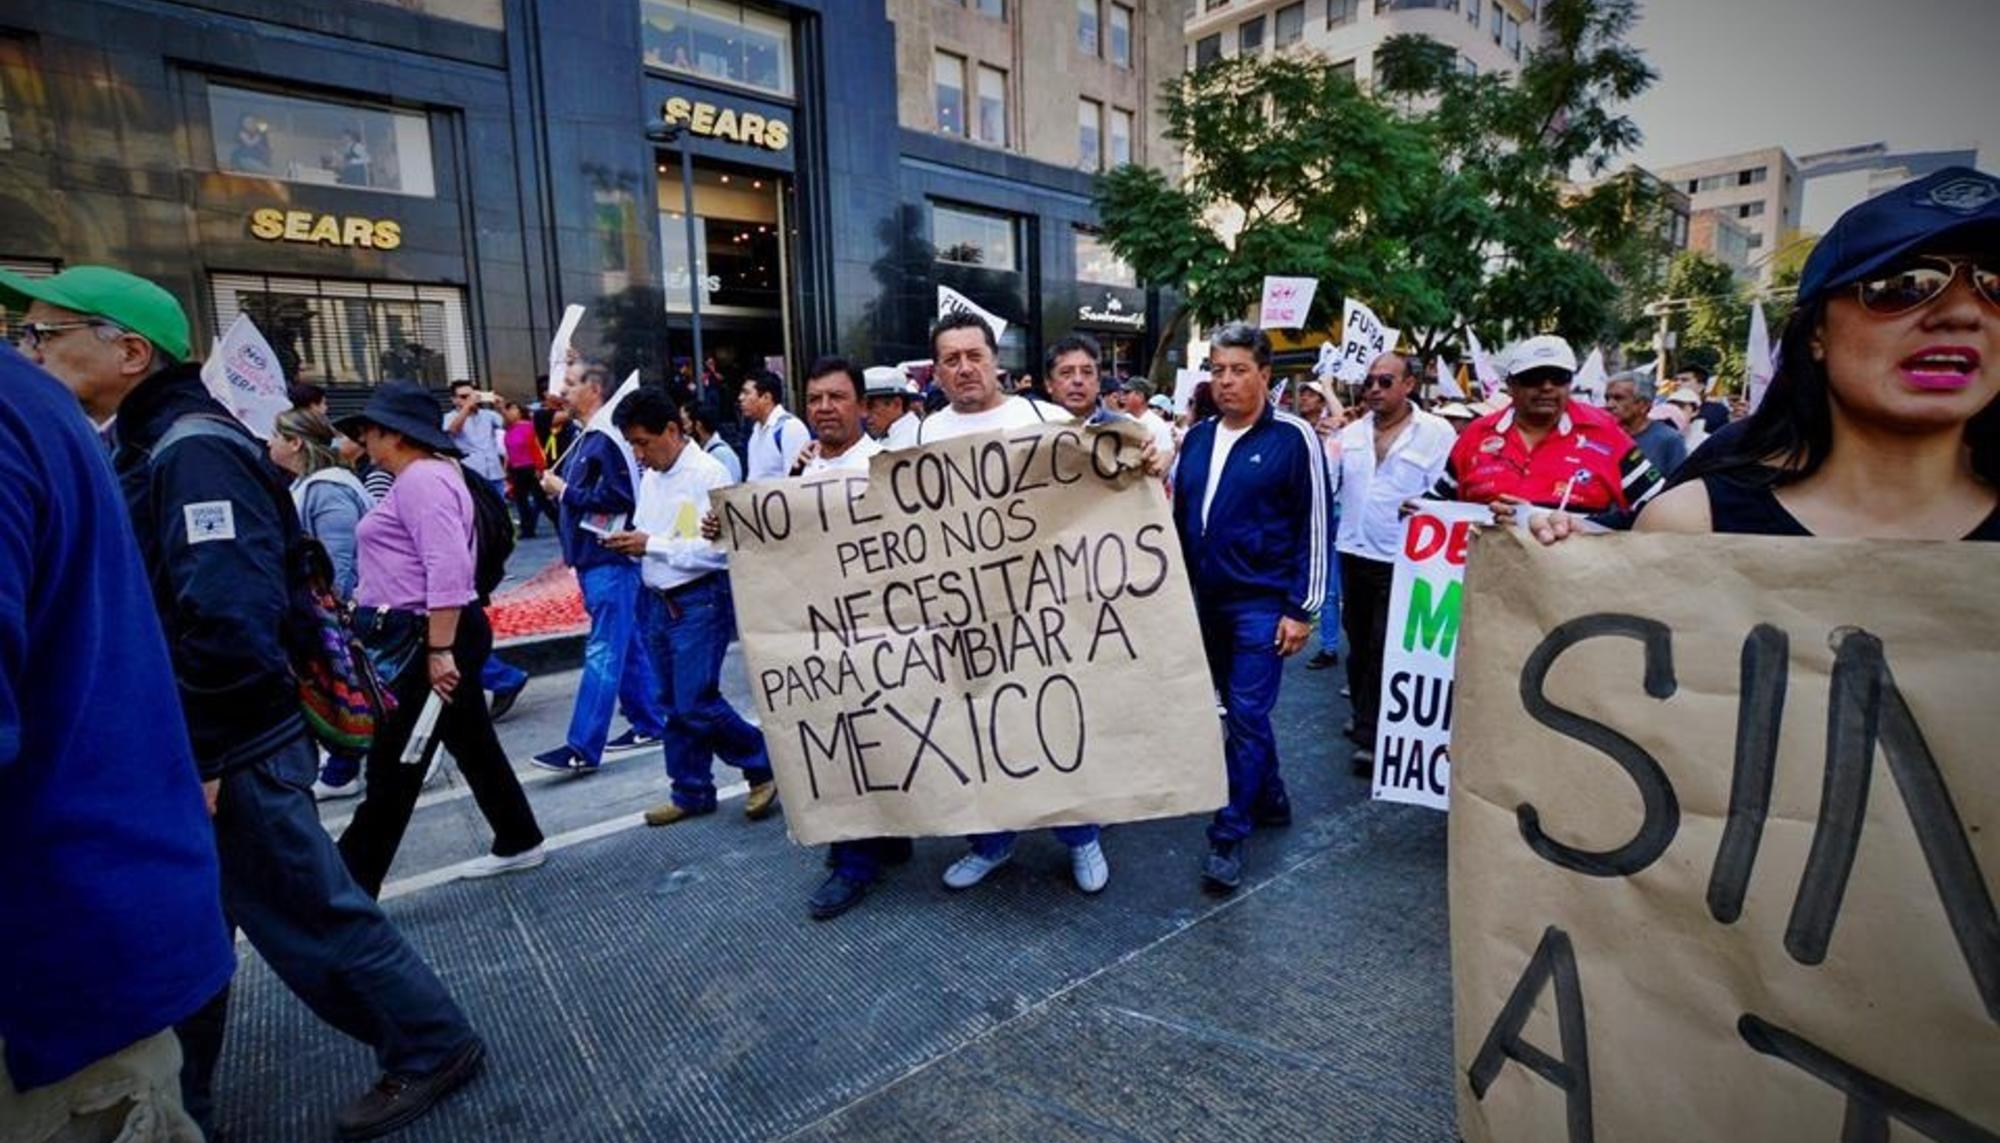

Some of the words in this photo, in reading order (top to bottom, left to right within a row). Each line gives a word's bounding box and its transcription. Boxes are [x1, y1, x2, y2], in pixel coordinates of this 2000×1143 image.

[663, 97, 789, 150] SEARS
[250, 208, 401, 250] SEARS
[723, 489, 791, 551] NO
[801, 476, 883, 532] TE
[891, 430, 1123, 515] CONOZCO
[836, 523, 927, 578] PERO
[941, 499, 1037, 558] NOS
[808, 523, 1169, 651] NECESITAMOS
[761, 650, 866, 713] PARA
[872, 605, 1073, 690] CAMBIAR
[1088, 601, 1138, 662] A
[1386, 671, 1453, 735] SU
[797, 673, 1086, 800] MÉXICO
[1516, 612, 2000, 1026] SIN
[1468, 925, 1595, 1143] A
